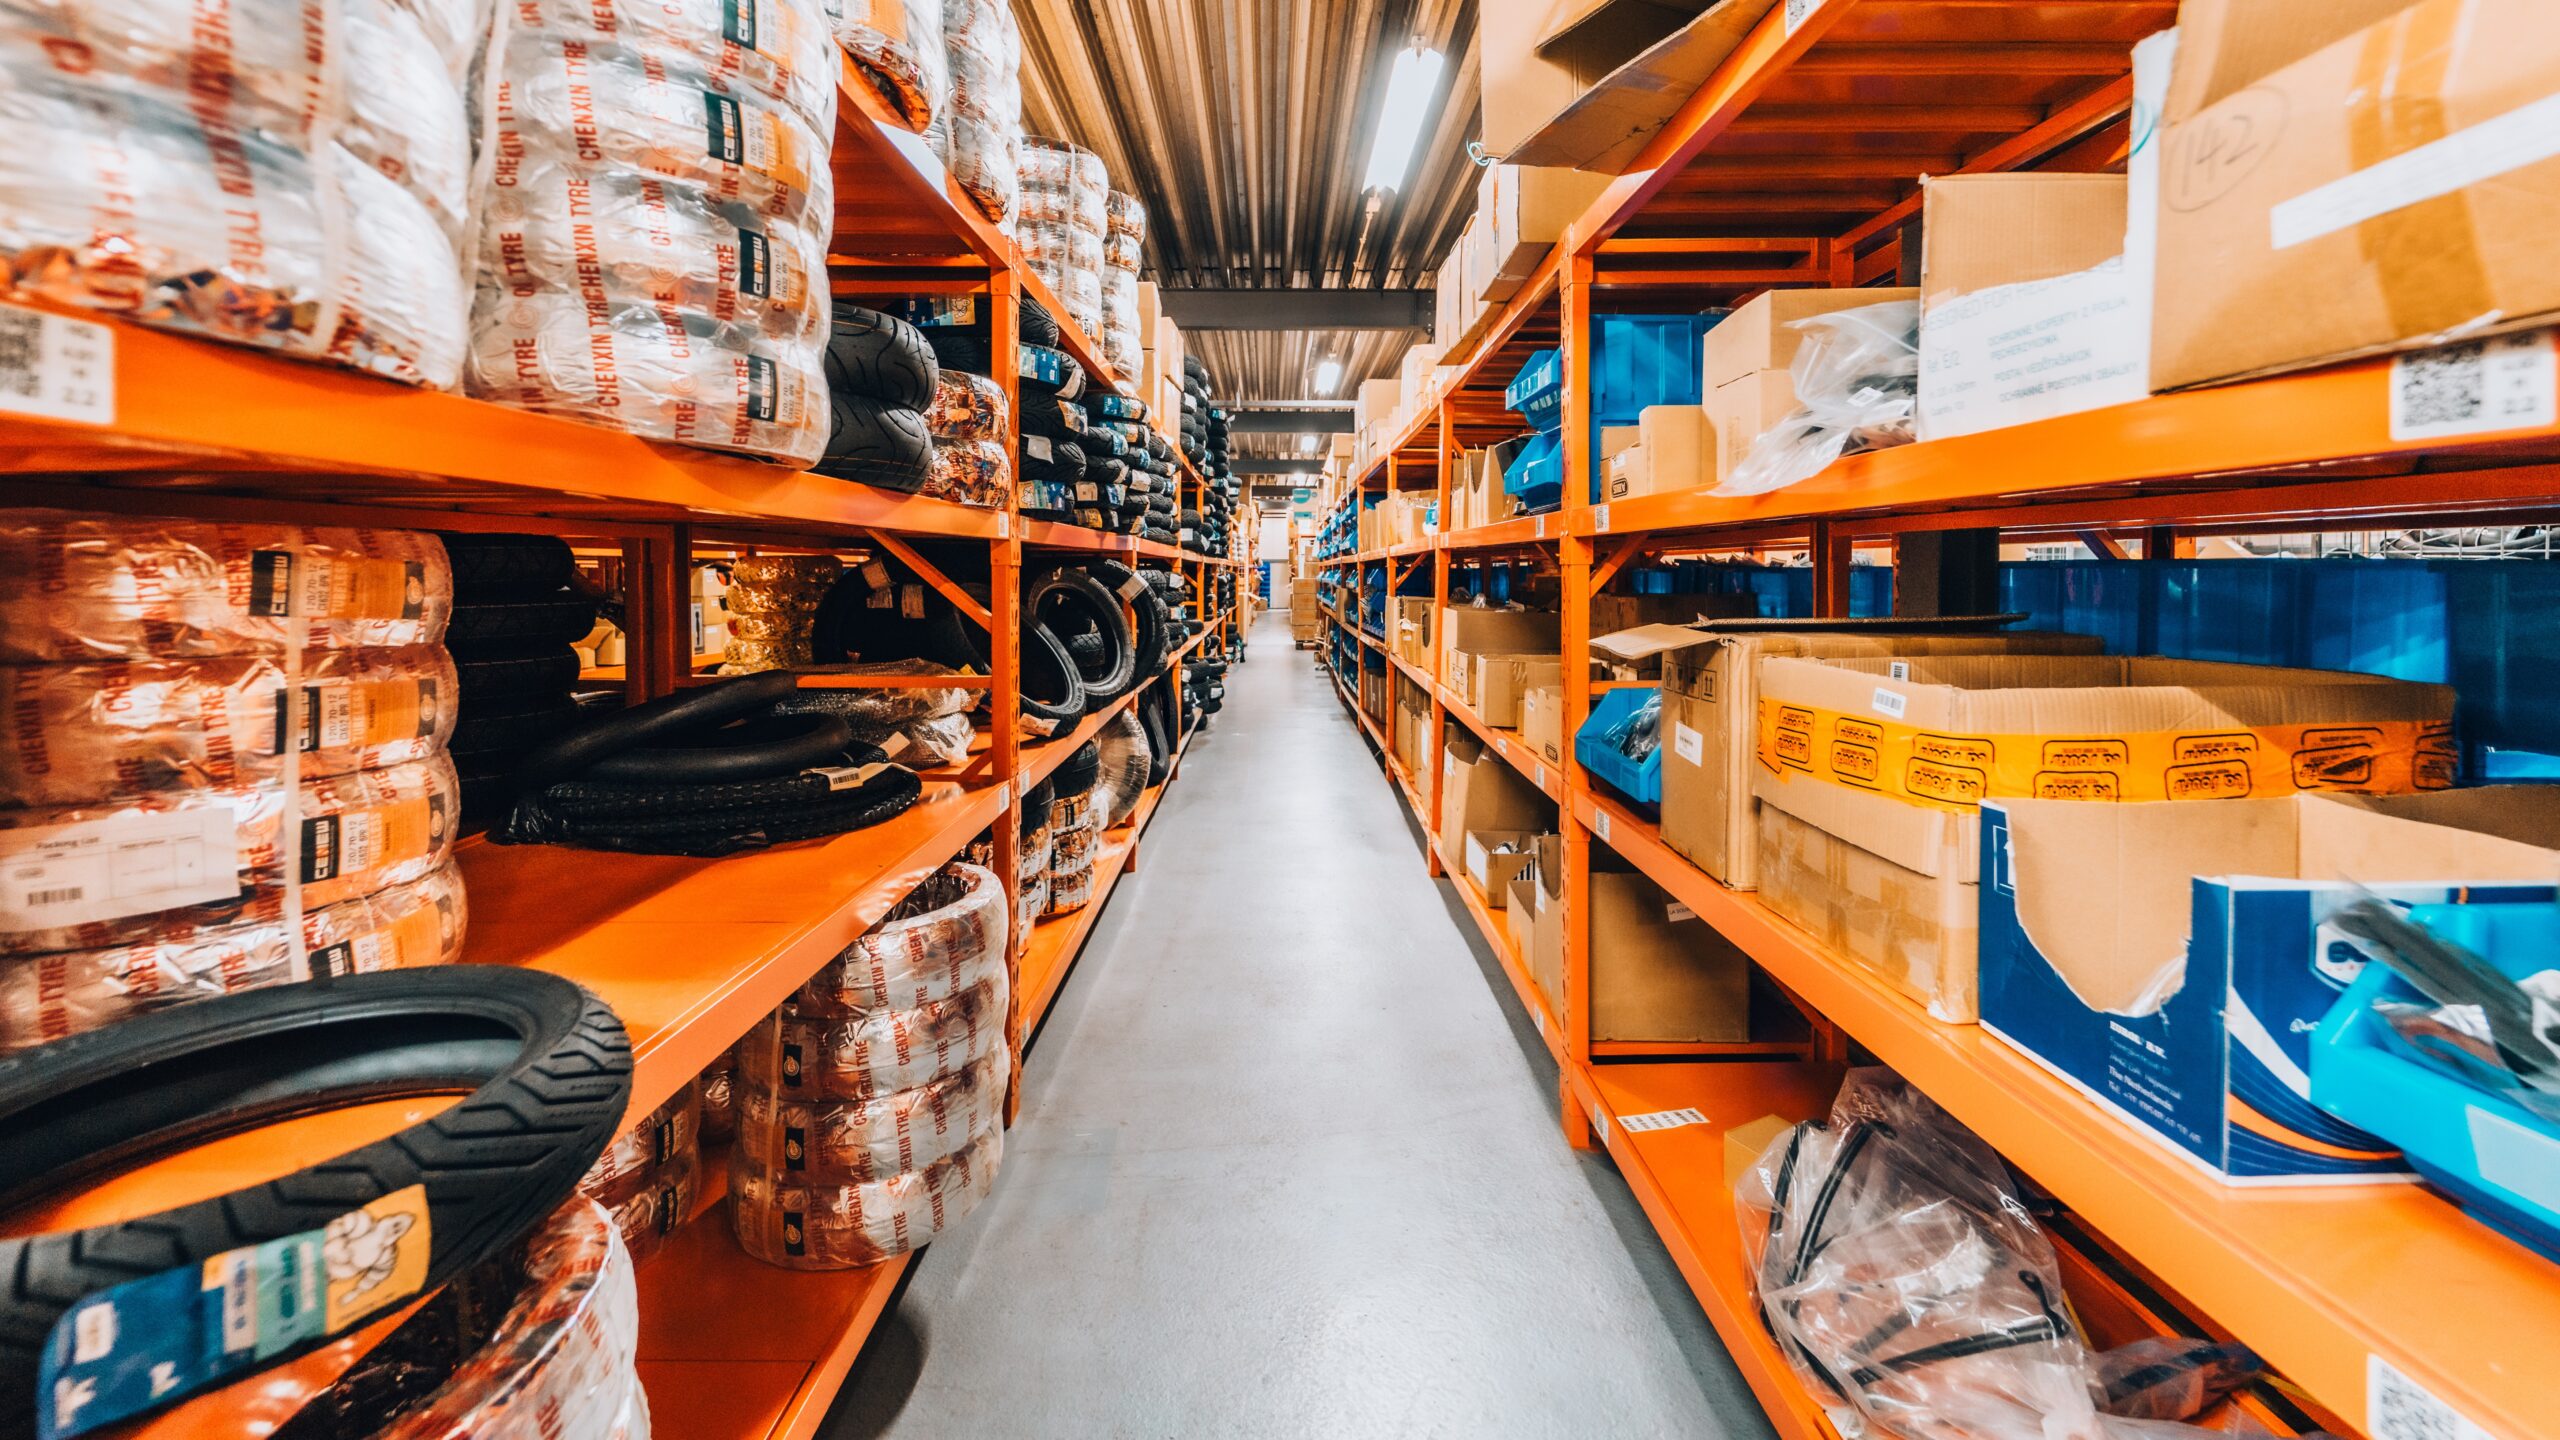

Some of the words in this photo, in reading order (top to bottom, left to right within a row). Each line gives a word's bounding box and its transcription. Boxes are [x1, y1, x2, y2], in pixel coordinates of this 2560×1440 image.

[563, 39, 589, 77] TYRE
[569, 84, 602, 162] CHENXIN
[719, 99, 736, 162] CENEW
[2181, 113, 2260, 200] 142
[567, 178, 593, 217] TYRE
[501, 232, 528, 277] TYRE
[716, 243, 736, 284] TYRE
[752, 236, 764, 294] CENEW
[513, 337, 541, 382] TYRE
[591, 333, 621, 408] CHENXIN
[759, 361, 771, 420] CENEW
[674, 402, 697, 440] TYRE
[732, 402, 752, 446] ENXIN
[271, 555, 289, 616] CENEW
[305, 563, 318, 612] 120/70-12
[330, 560, 350, 615] TUBELESS
[201, 686, 230, 732] TYRE
[327, 693, 339, 743] 120/70-12
[350, 687, 367, 742] TUBELESS
[314, 819, 330, 880] CENEW
[347, 819, 358, 869] 120/70-12
[368, 811, 384, 866] TUBELESS
[867, 935, 883, 964] TYRE
[905, 927, 926, 963] CHENX
[39, 955, 67, 1005] TYRE
[870, 965, 890, 1010] CHENXIN
[894, 1021, 911, 1067] CHENXIN
[936, 1039, 949, 1066] TYRE
[2108, 1064, 2124, 1082] The
[2123, 1072, 2175, 1113] Netherlands
[895, 1108, 911, 1137] TYRE
[600, 1146, 618, 1182] ENXIN
[894, 1211, 908, 1239] TYRE
[931, 1192, 945, 1234] CHENXIN
